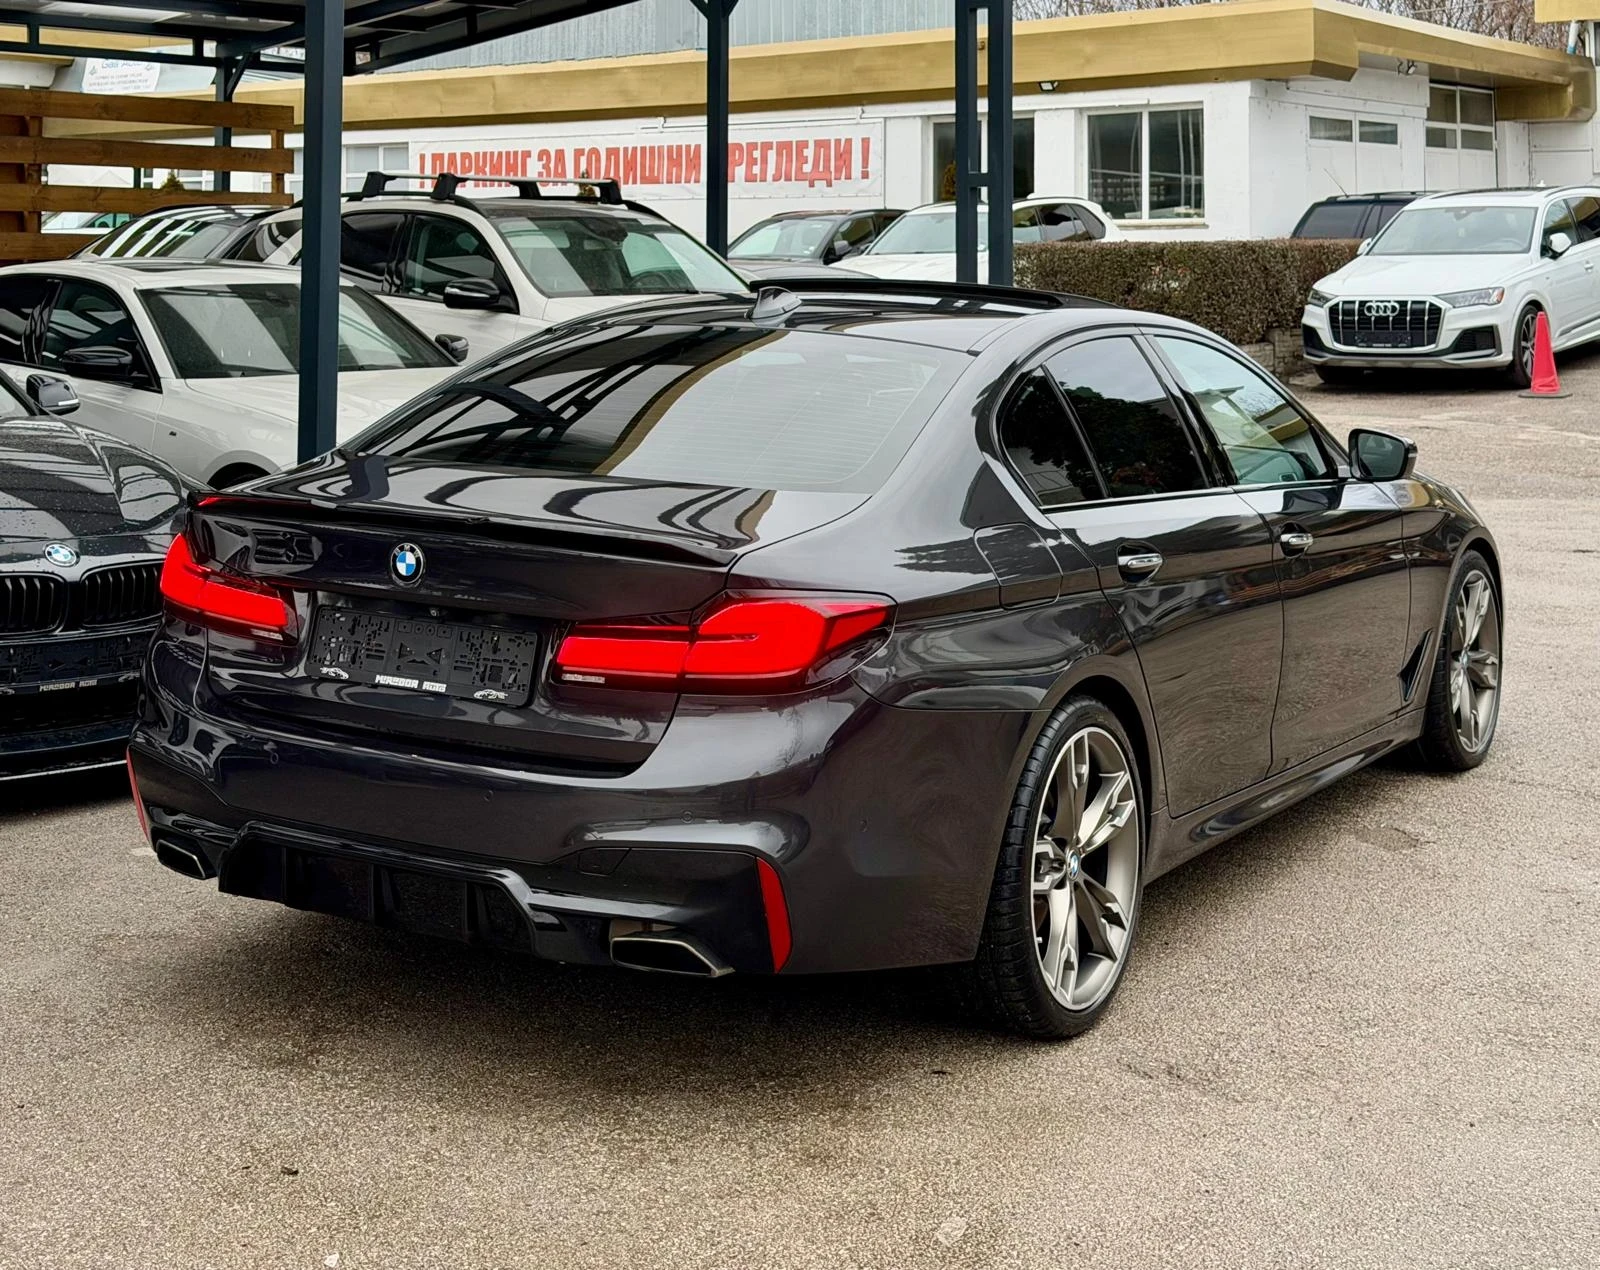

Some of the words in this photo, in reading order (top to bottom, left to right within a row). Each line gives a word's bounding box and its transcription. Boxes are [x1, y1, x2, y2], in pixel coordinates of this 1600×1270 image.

[431, 150, 532, 188] ПАРКИНГ
[537, 148, 567, 187] ЗА
[574, 144, 701, 188] ГОДИШНИ
[728, 138, 852, 187] РЕГЛЕДИ
[861, 137, 870, 179] !
